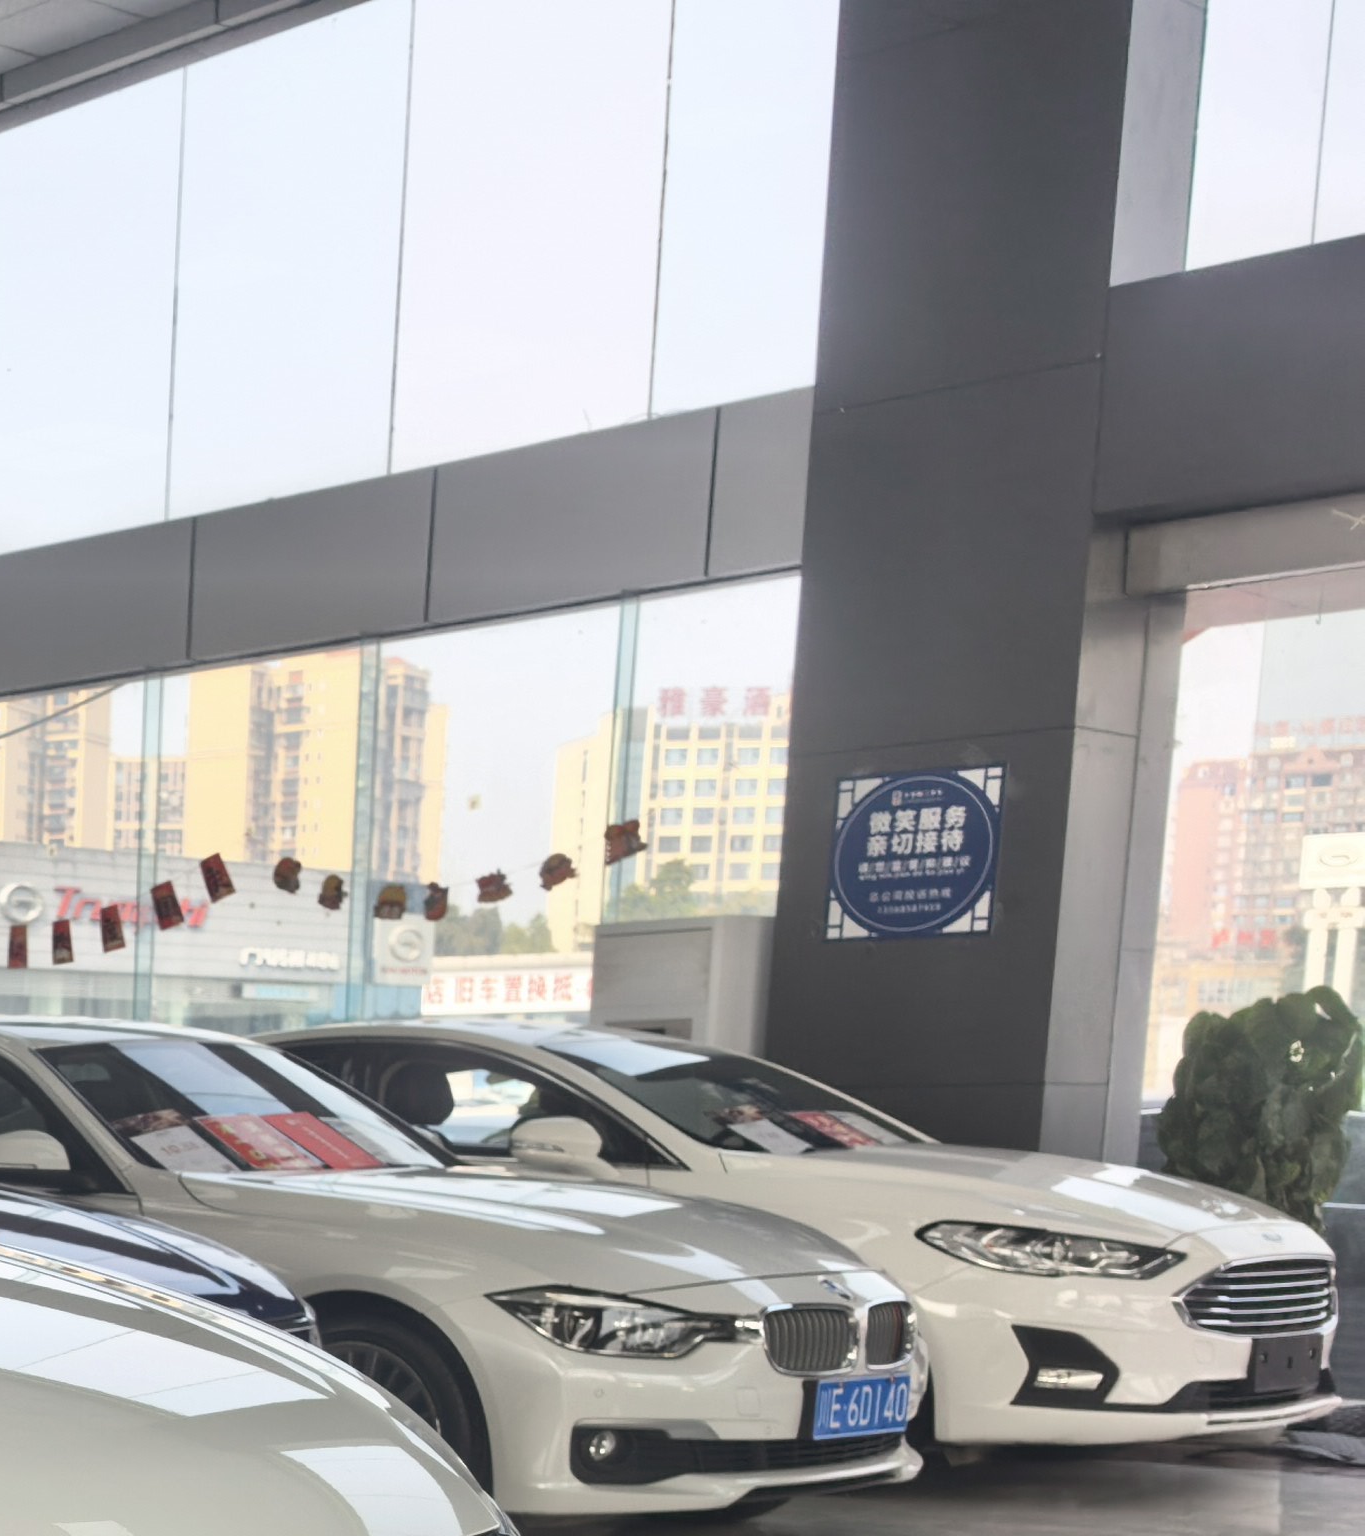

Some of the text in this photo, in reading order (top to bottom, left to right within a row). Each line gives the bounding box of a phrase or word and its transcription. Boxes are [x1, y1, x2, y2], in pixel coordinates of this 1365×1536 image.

[869, 805, 967, 835] 微笑服务
[866, 829, 965, 858] 亲切接待
